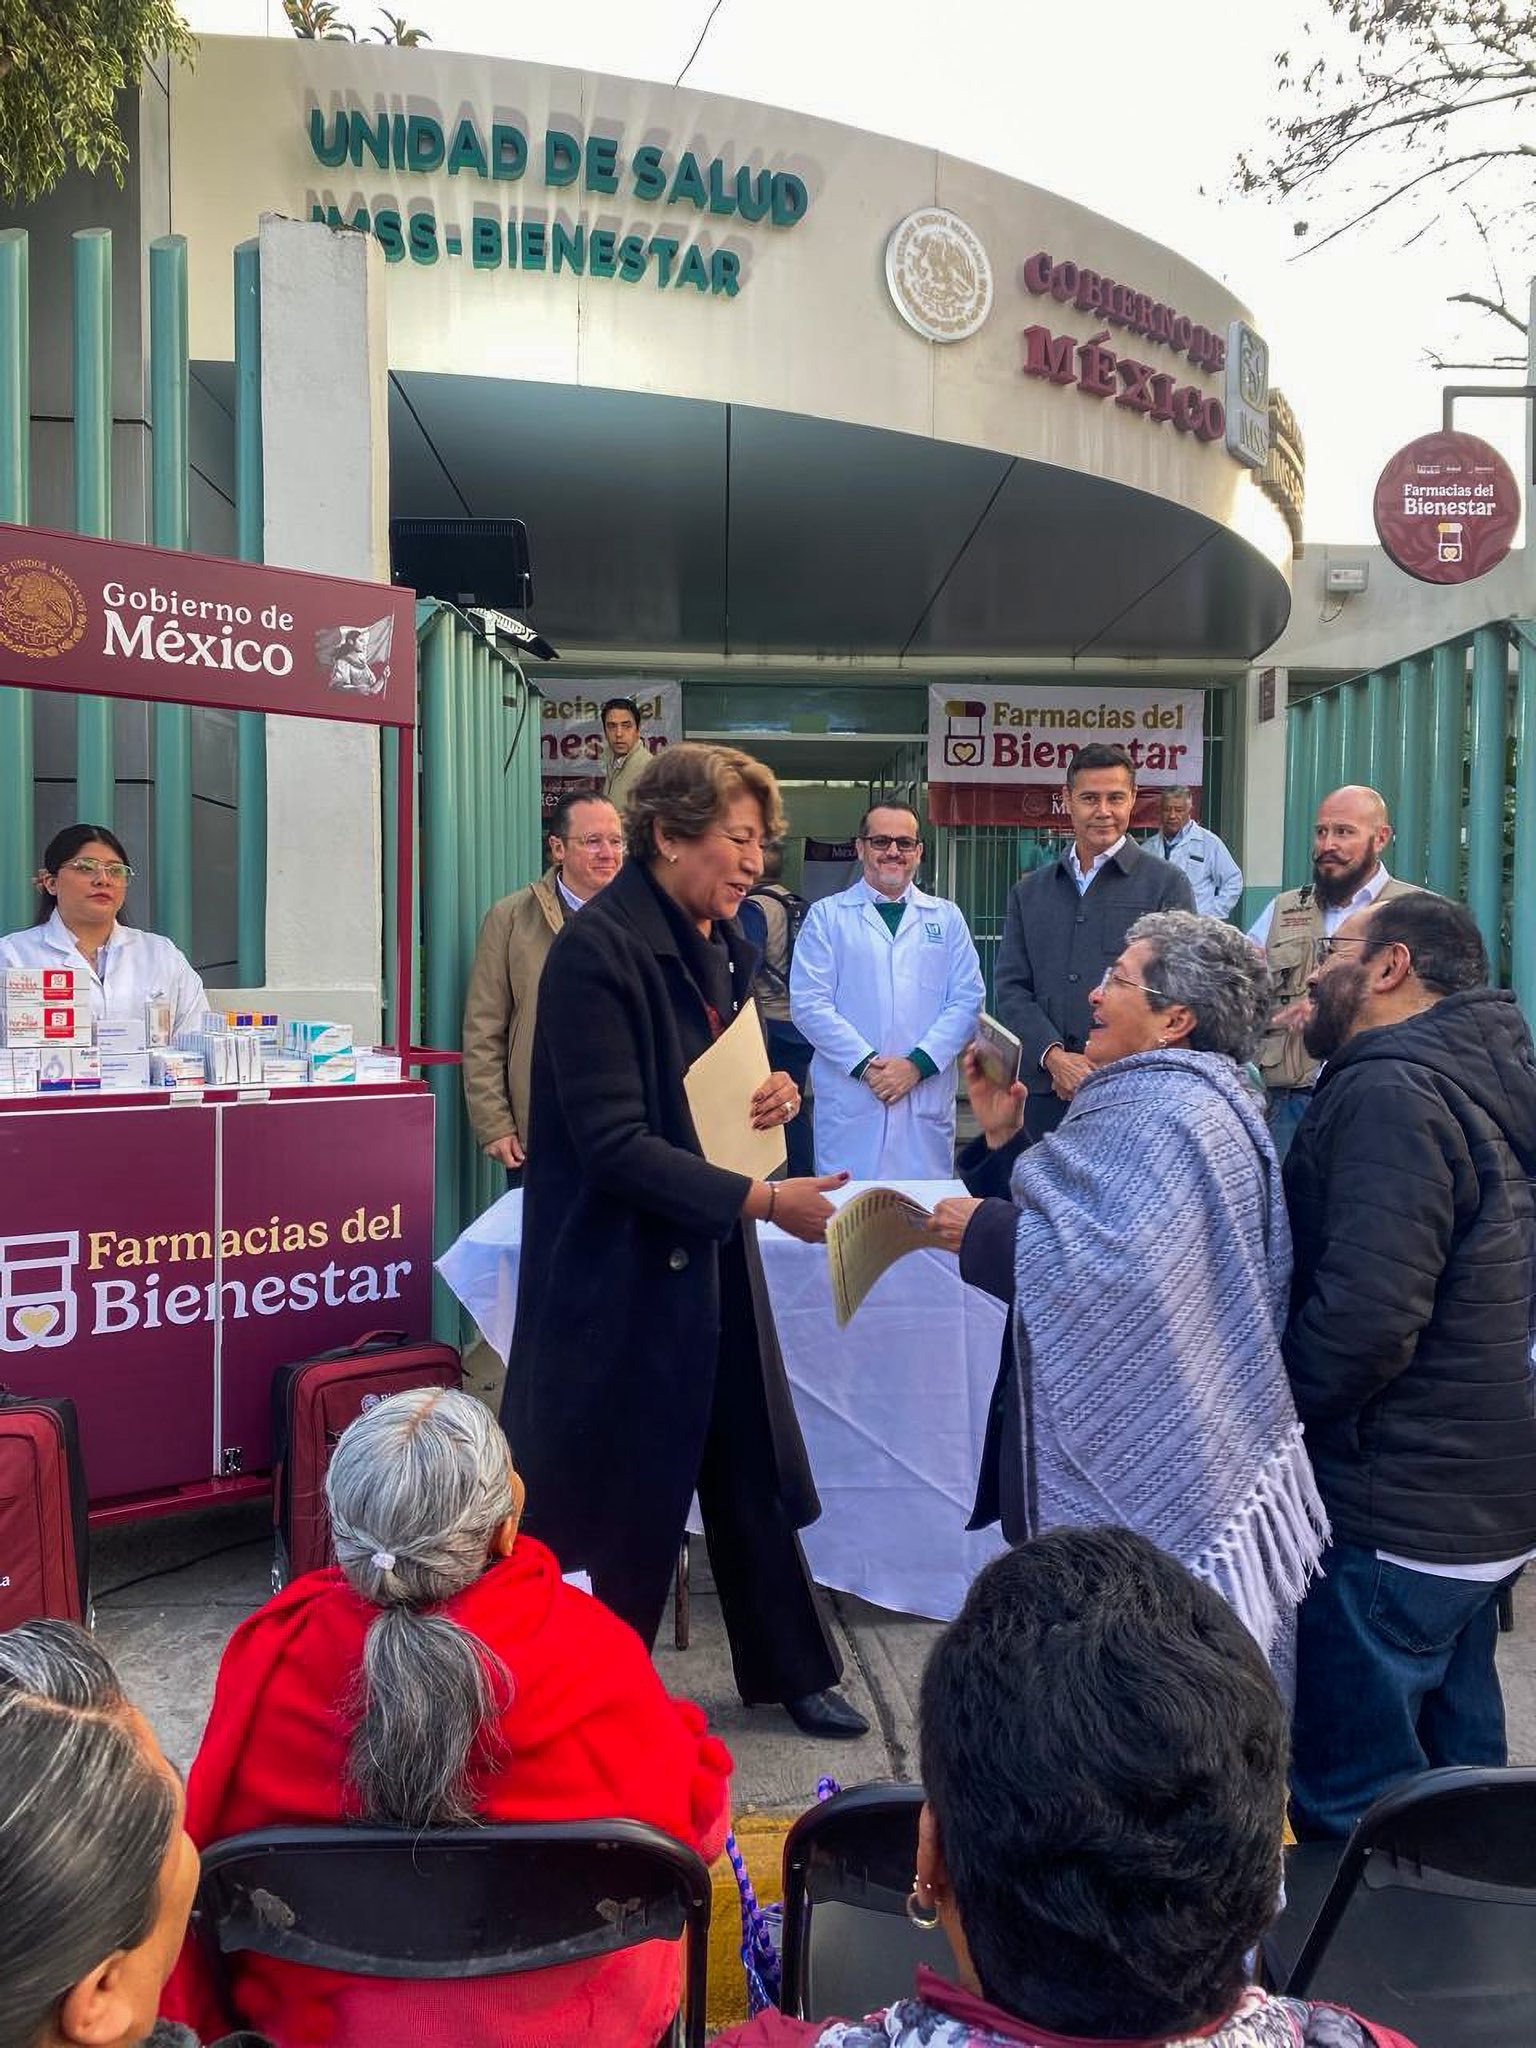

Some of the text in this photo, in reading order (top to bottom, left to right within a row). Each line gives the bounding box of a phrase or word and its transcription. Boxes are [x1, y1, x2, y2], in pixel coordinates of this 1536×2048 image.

[310, 109, 810, 228] UNIDAD DE SALUD
[1024, 252, 1192, 352] GOBIERNO
[1023, 325, 1225, 442] MÉXICO
[1404, 483, 1494, 497] Farmacias del
[1404, 497, 1497, 516] Bienestar
[102, 582, 295, 633] Gobierno de
[102, 610, 294, 677] México
[993, 702, 1185, 731] Farmacias del
[992, 733, 1188, 771] Bientar
[87, 1203, 403, 1271] Farmacias del
[91, 1260, 413, 1336] Bienestar
